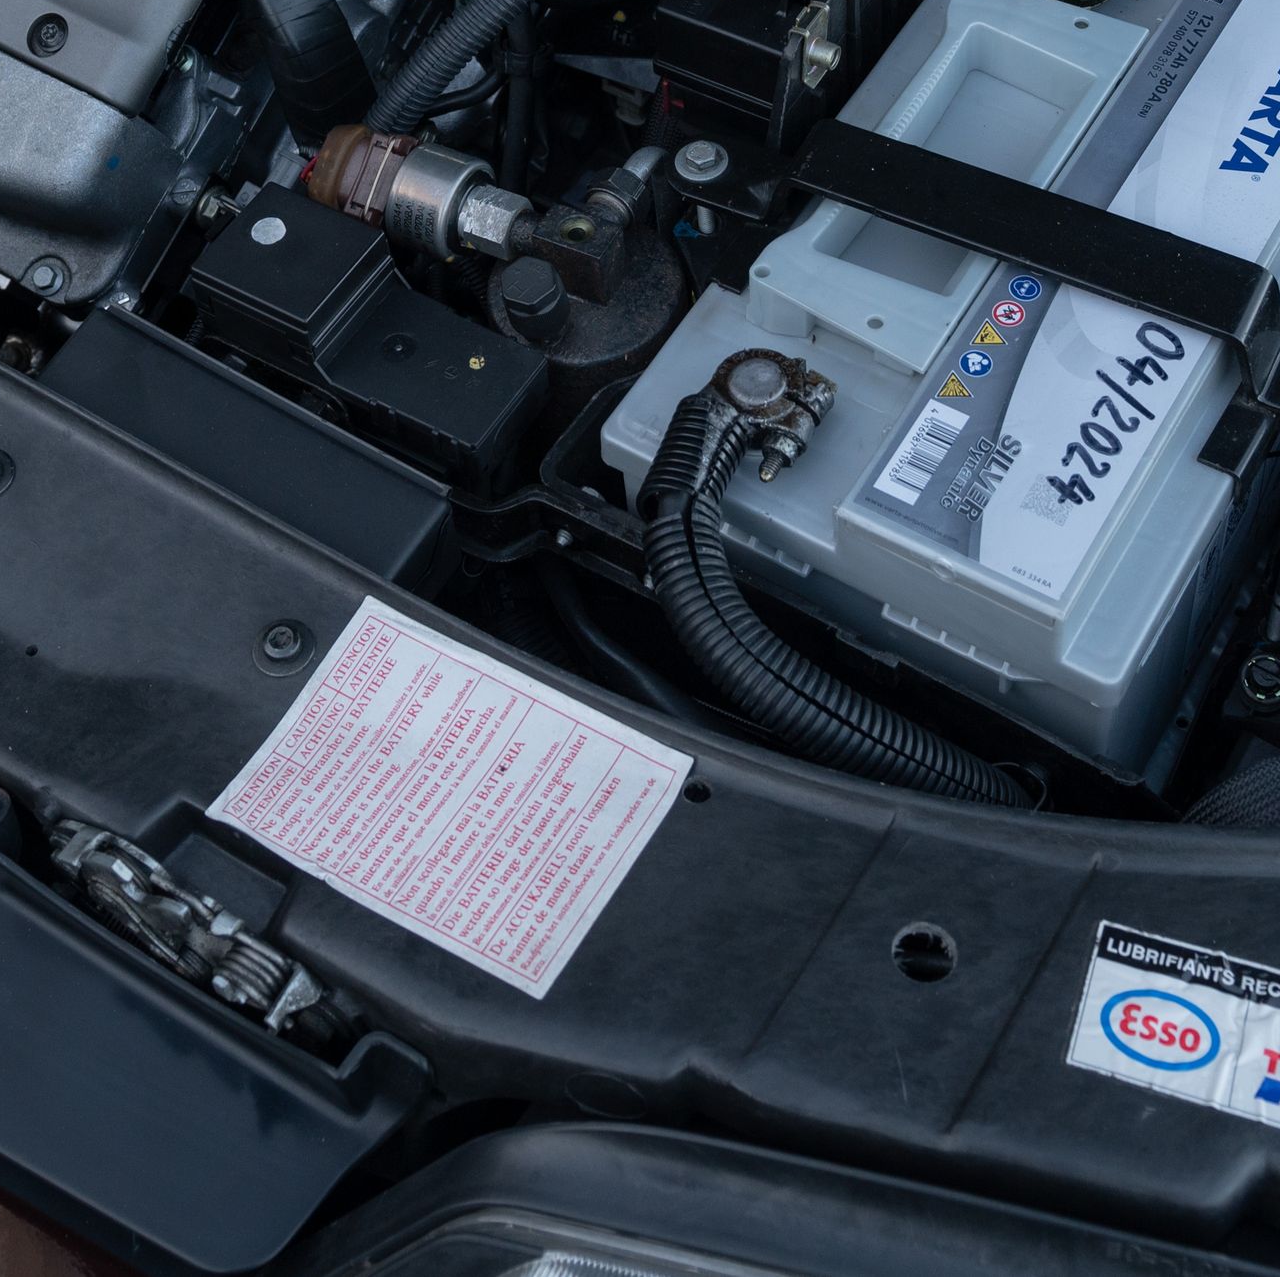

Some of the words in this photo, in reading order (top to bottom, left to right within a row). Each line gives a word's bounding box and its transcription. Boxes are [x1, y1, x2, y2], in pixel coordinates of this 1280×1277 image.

[1152, 55, 1167, 71] 316
[1162, 40, 1177, 56] 078
[1172, 25, 1187, 40] 400
[1183, 9, 1198, 25] 577
[1147, 70, 1157, 78] 2
[1046, 321, 1184, 504] 04/2024
[939, 436, 994, 512] Dynamic
[967, 433, 1022, 523] SILVER
[332, 627, 375, 684] ATENCION
[349, 634, 391, 691] ATTENTIE
[259, 819, 276, 833] Ne
[272, 787, 302, 819] jamais
[300, 732, 345, 785] débrancher
[340, 721, 354, 731] la
[349, 656, 397, 719] BATTERIE
[285, 695, 326, 748] CAUTION
[300, 702, 344, 759] ACHTUNG
[301, 826, 329, 855] Never
[327, 775, 370, 825] disconnect
[367, 758, 383, 773] the
[379, 698, 423, 756] BATTERY
[421, 672, 443, 698] while
[242, 765, 297, 825] ATTENZIONE
[272, 806, 305, 840] lorsque
[301, 795, 315, 804] le
[313, 758, 343, 793] moteur
[341, 724, 371, 757] tourne.
[316, 846, 332, 862] the
[332, 812, 359, 844] engine
[355, 802, 368, 811] is
[366, 763, 400, 800] running.
[343, 862, 360, 877] No
[358, 803, 405, 859] desconectar
[403, 774, 429, 802] nunca
[423, 762, 438, 772] la
[432, 709, 475, 760] BATERIA
[392, 824, 409, 842] que
[407, 811, 418, 822] el
[416, 781, 441, 811] motor
[439, 761, 457, 780] este
[455, 746, 468, 759] en
[466, 705, 496, 744] marcha.
[395, 884, 420, 906] Non
[417, 834, 456, 882] scollegare
[454, 812, 472, 832] mai
[466, 802, 481, 812] la
[475, 742, 526, 800] BATTERIA
[414, 876, 444, 913] quando
[450, 830, 479, 865] motore
[481, 809, 495, 819] in
[493, 781, 516, 807] moto.
[442, 911, 462, 929] Die
[457, 848, 507, 908] BATTERIE
[503, 824, 524, 847] darf
[521, 800, 542, 825] nicht
[540, 734, 587, 799] ausgeschaltet
[459, 901, 490, 936] werden
[487, 886, 499, 899] so
[494, 858, 520, 885] lange
[517, 838, 534, 856] der
[531, 806, 556, 837] motor
[551, 782, 576, 805] läuft.
[490, 939, 507, 955] De
[505, 852, 567, 937] ACCUKABELS
[565, 824, 588, 852] nooit
[582, 776, 620, 822] losmaken
[509, 924, 536, 961] wanner
[534, 910, 548, 923] de
[546, 876, 570, 908] motor
[567, 844, 595, 875] draait.
[1106, 937, 1235, 986] LUBRIFIANTS
